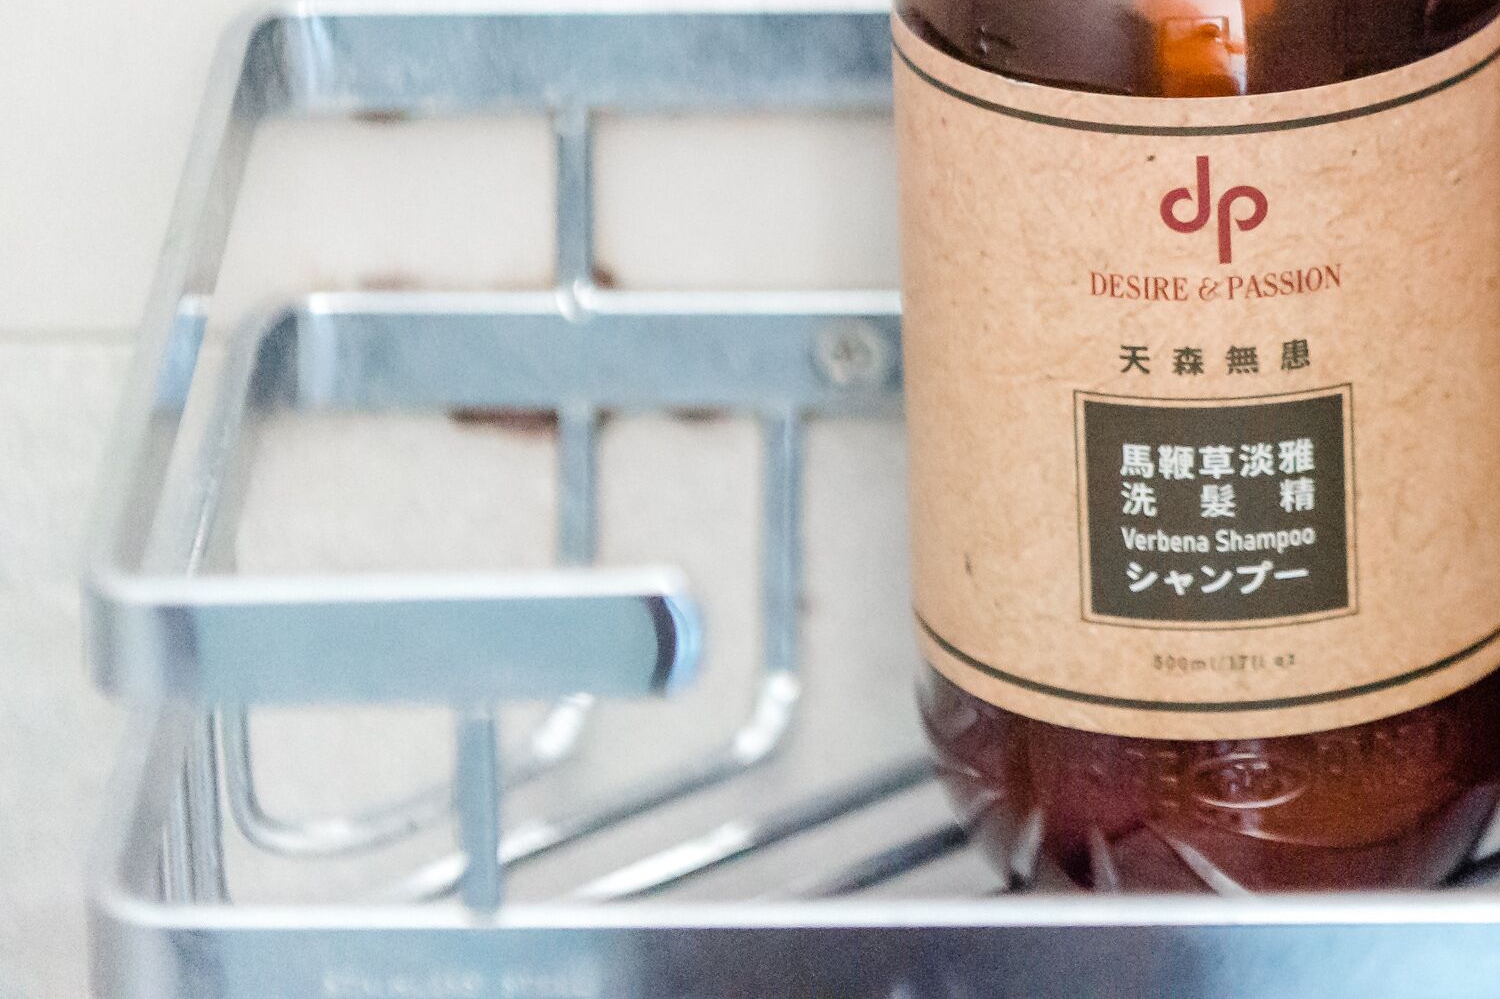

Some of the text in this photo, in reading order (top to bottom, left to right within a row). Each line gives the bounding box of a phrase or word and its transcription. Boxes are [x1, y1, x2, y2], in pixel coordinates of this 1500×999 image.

[1089, 263, 1343, 301] DESIRE & PASSION
[1120, 437, 1315, 480] 馬鞭草淡雅
[1121, 526, 1315, 554] Verbena Shampoo
[1126, 560, 1309, 595] シャンプー
